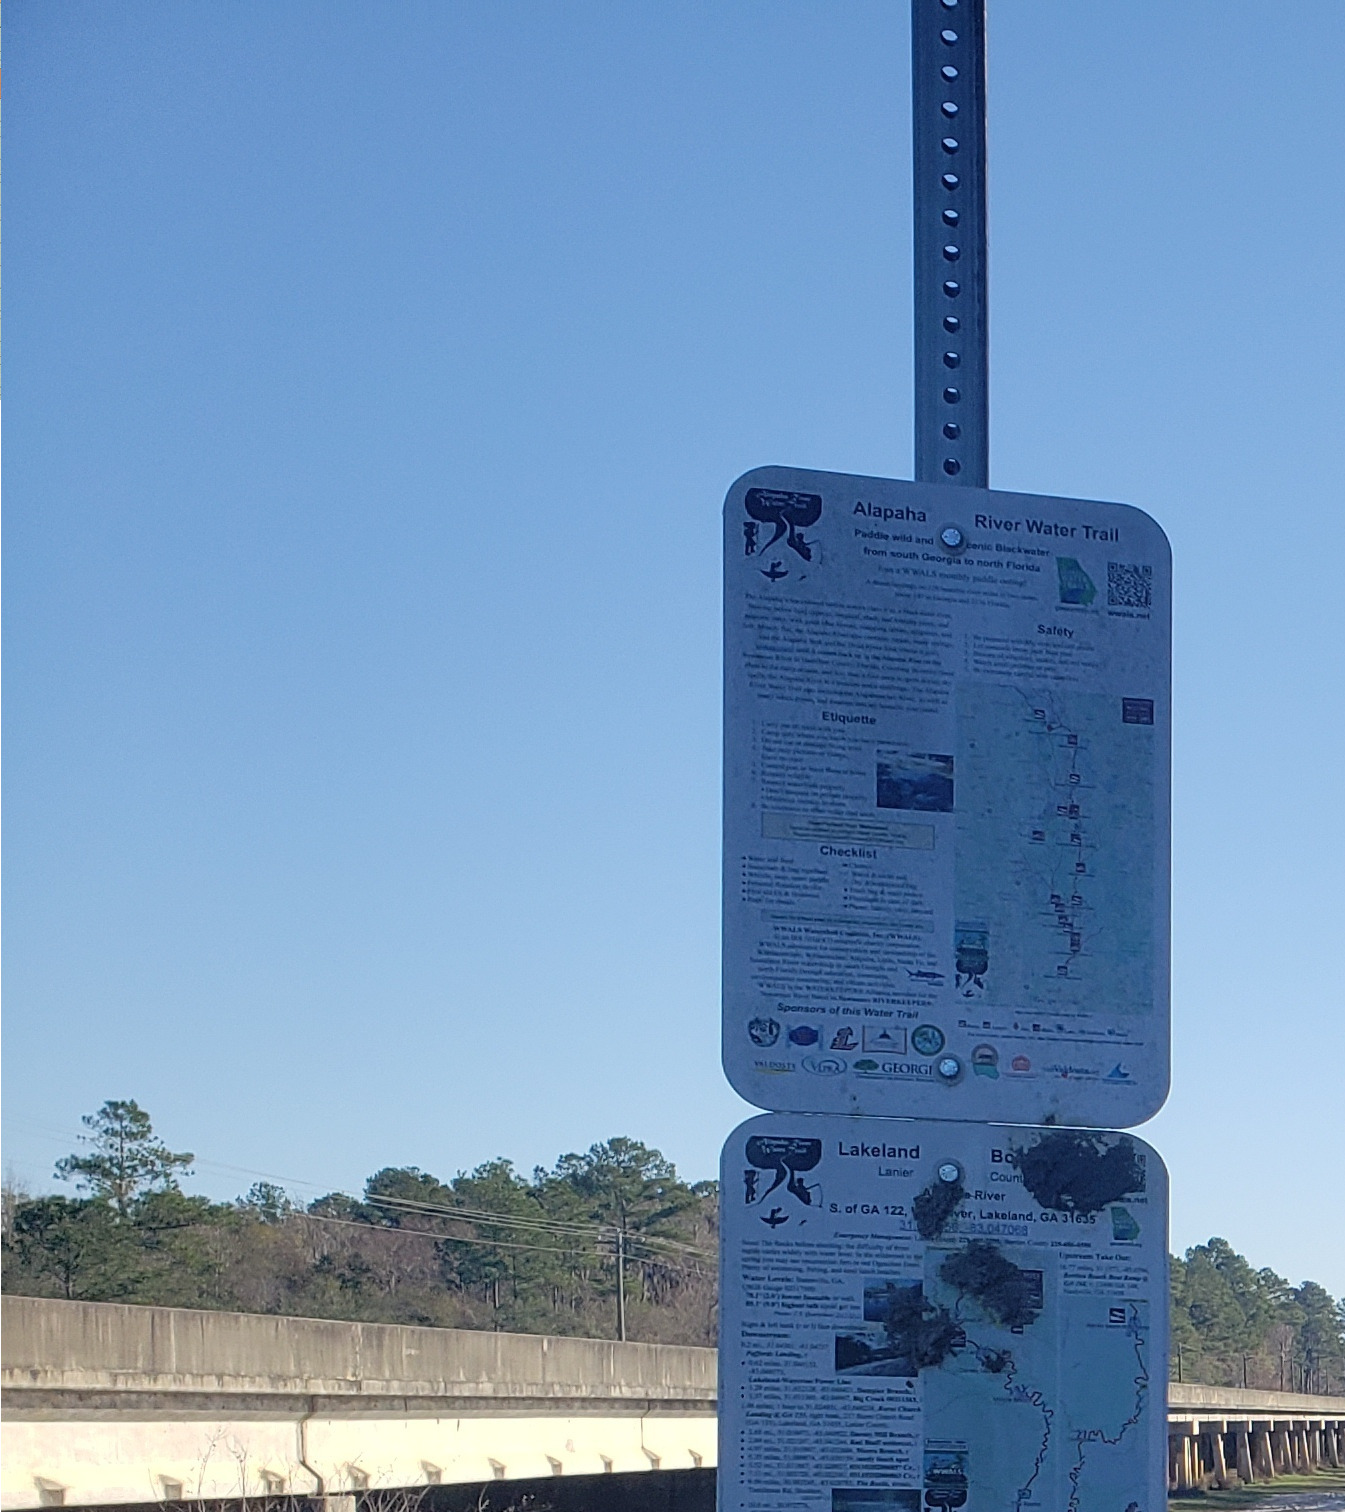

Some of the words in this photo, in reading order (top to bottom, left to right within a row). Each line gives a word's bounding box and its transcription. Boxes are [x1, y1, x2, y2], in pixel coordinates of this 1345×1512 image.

[853, 501, 927, 522] Alapaha
[974, 513, 1021, 532] River
[1025, 519, 1077, 538] Water
[1082, 524, 1119, 543] Trail
[854, 529, 889, 541] Paddle
[892, 532, 912, 543] wild
[915, 535, 934, 545] and
[966, 542, 992, 552] cenic
[995, 543, 1050, 557] Blackwater
[863, 546, 887, 557] from
[890, 549, 918, 560] south
[922, 552, 962, 565] Georgia
[964, 556, 974, 566] to
[976, 558, 1004, 569] north
[1006, 560, 1041, 572] Florida
[1037, 623, 1075, 639] Safety
[822, 711, 877, 725] Etiquette
[820, 845, 878, 860] Checklist
[777, 1002, 826, 1014] Sponsors
[829, 1004, 840, 1015] of
[842, 1005, 861, 1016] this
[864, 1007, 894, 1017] Water
[896, 1009, 919, 1019] Trail
[881, 1062, 932, 1076] GEORGI
[838, 1141, 920, 1160] Lakeland
[991, 1148, 1015, 1164] Bo
[878, 1165, 915, 1178] Lanier
[990, 1171, 1024, 1184] Count
[975, 1190, 1006, 1202] River
[829, 1202, 842, 1214] S.
[845, 1203, 858, 1214] of
[861, 1204, 880, 1215] GA
[884, 1205, 907, 1217] 122,
[953, 1210, 976, 1221] ver,
[980, 1209, 1037, 1223] Lakeland,
[1040, 1212, 1058, 1222] GA
[1061, 1212, 1096, 1224] 31635
